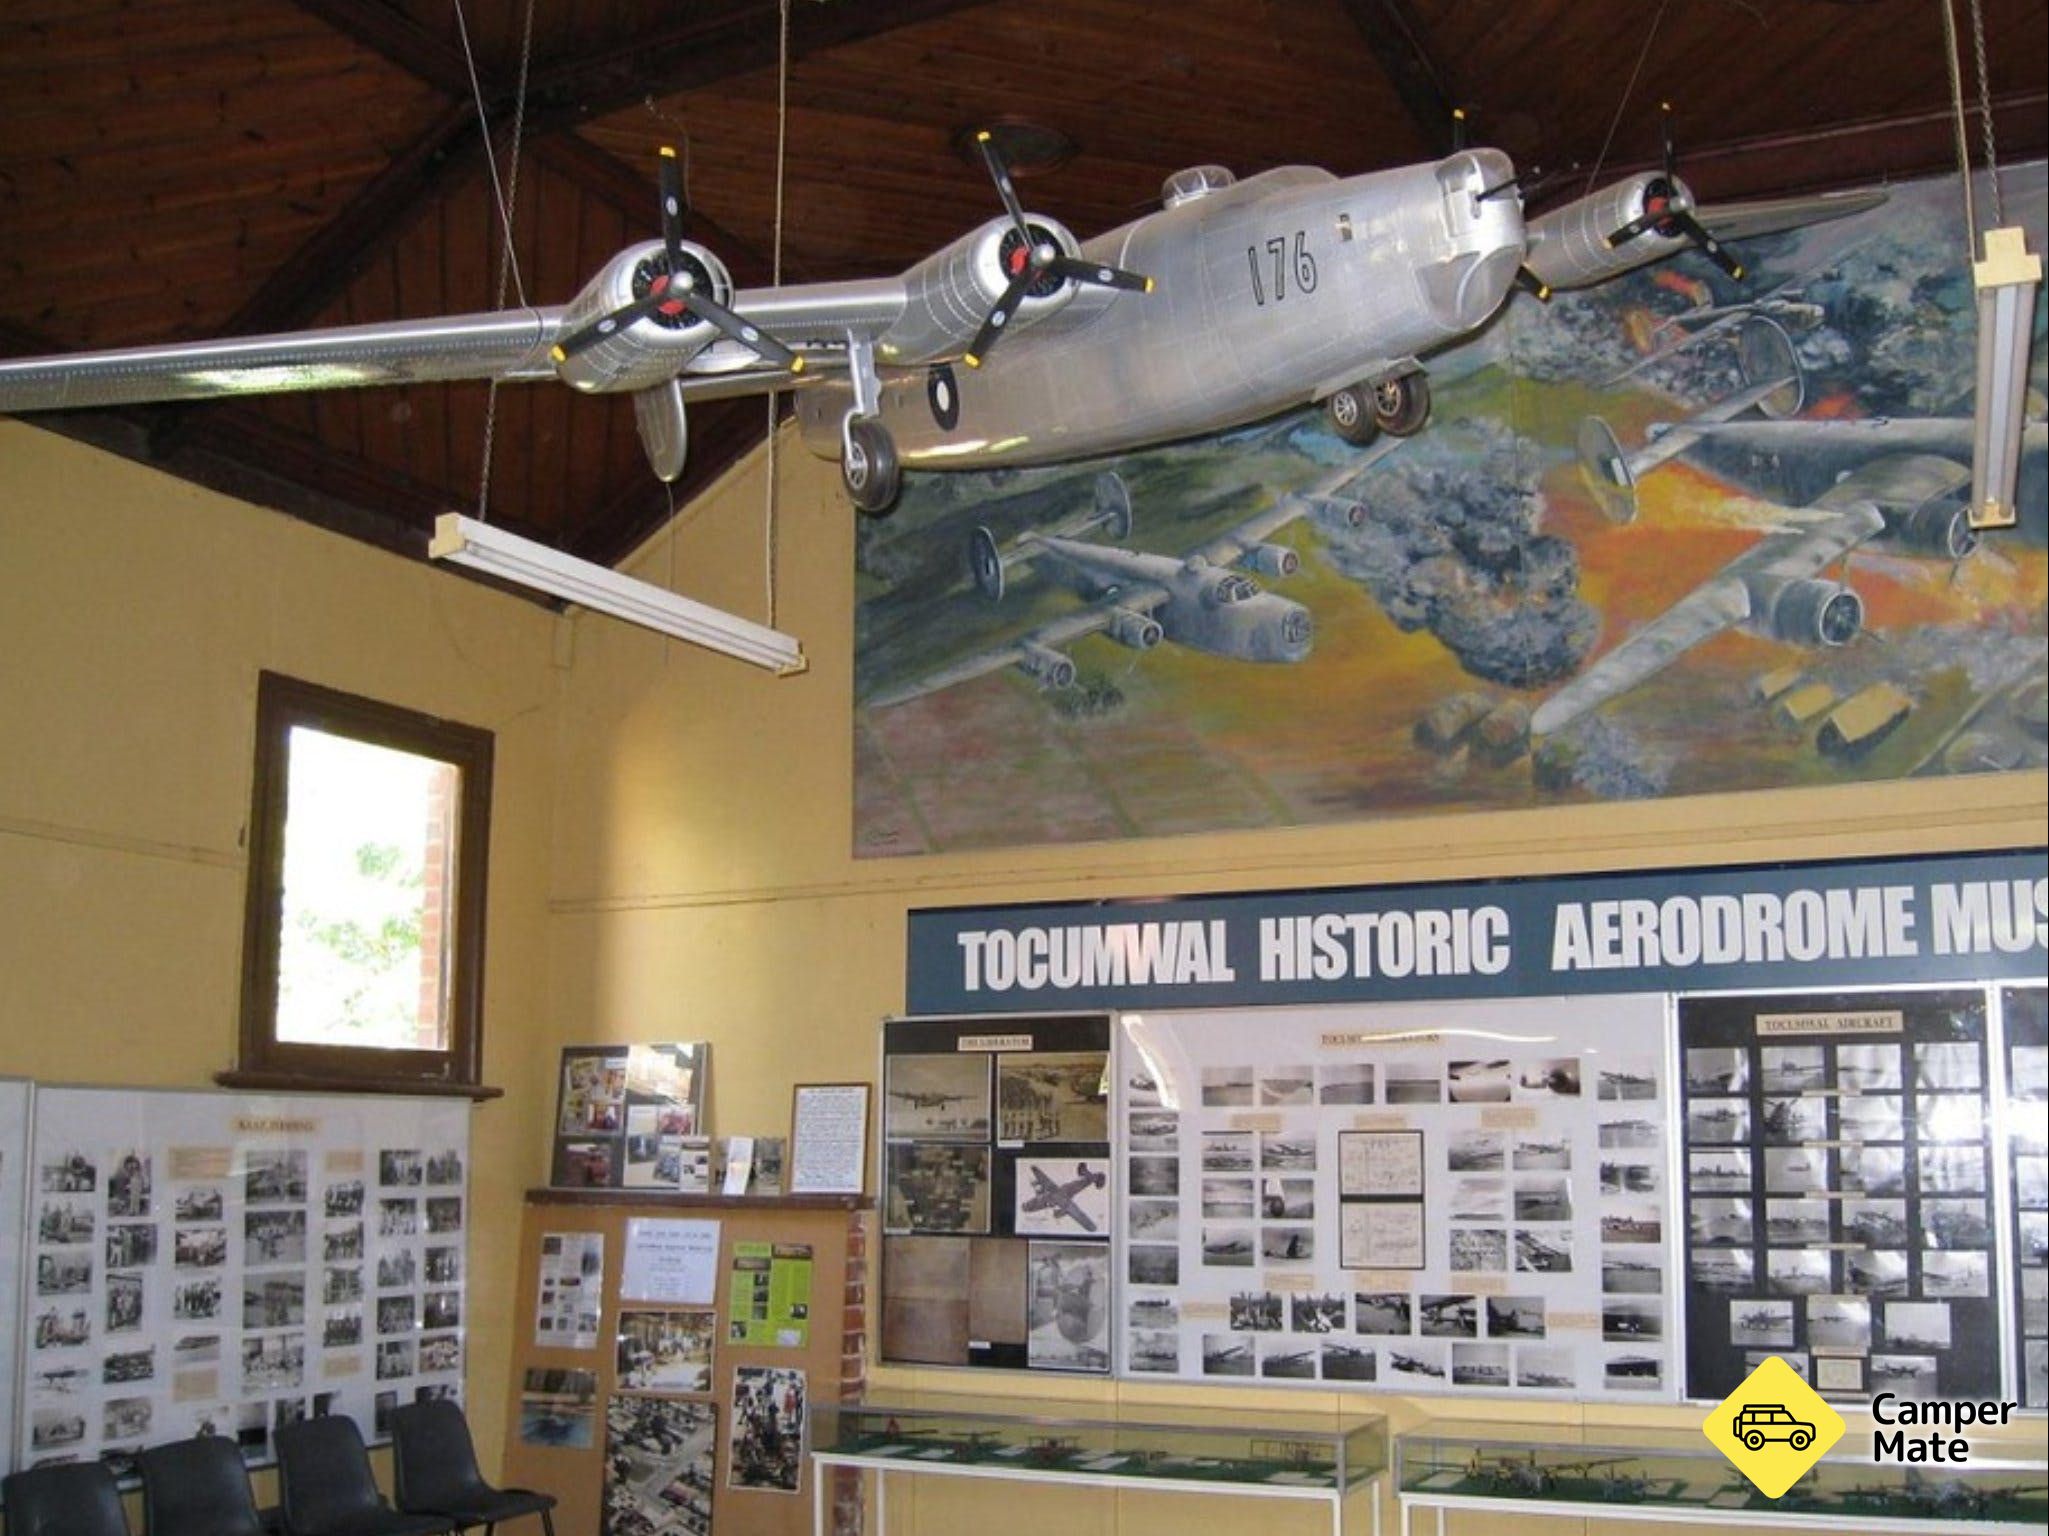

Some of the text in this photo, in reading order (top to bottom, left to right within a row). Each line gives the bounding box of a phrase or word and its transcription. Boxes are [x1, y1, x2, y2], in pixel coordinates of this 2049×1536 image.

[1248, 231, 1317, 305] 176
[957, 920, 1235, 991] TOCUMWAL
[1260, 906, 1511, 982] HISTORIC
[1551, 885, 1919, 971] AERODROME
